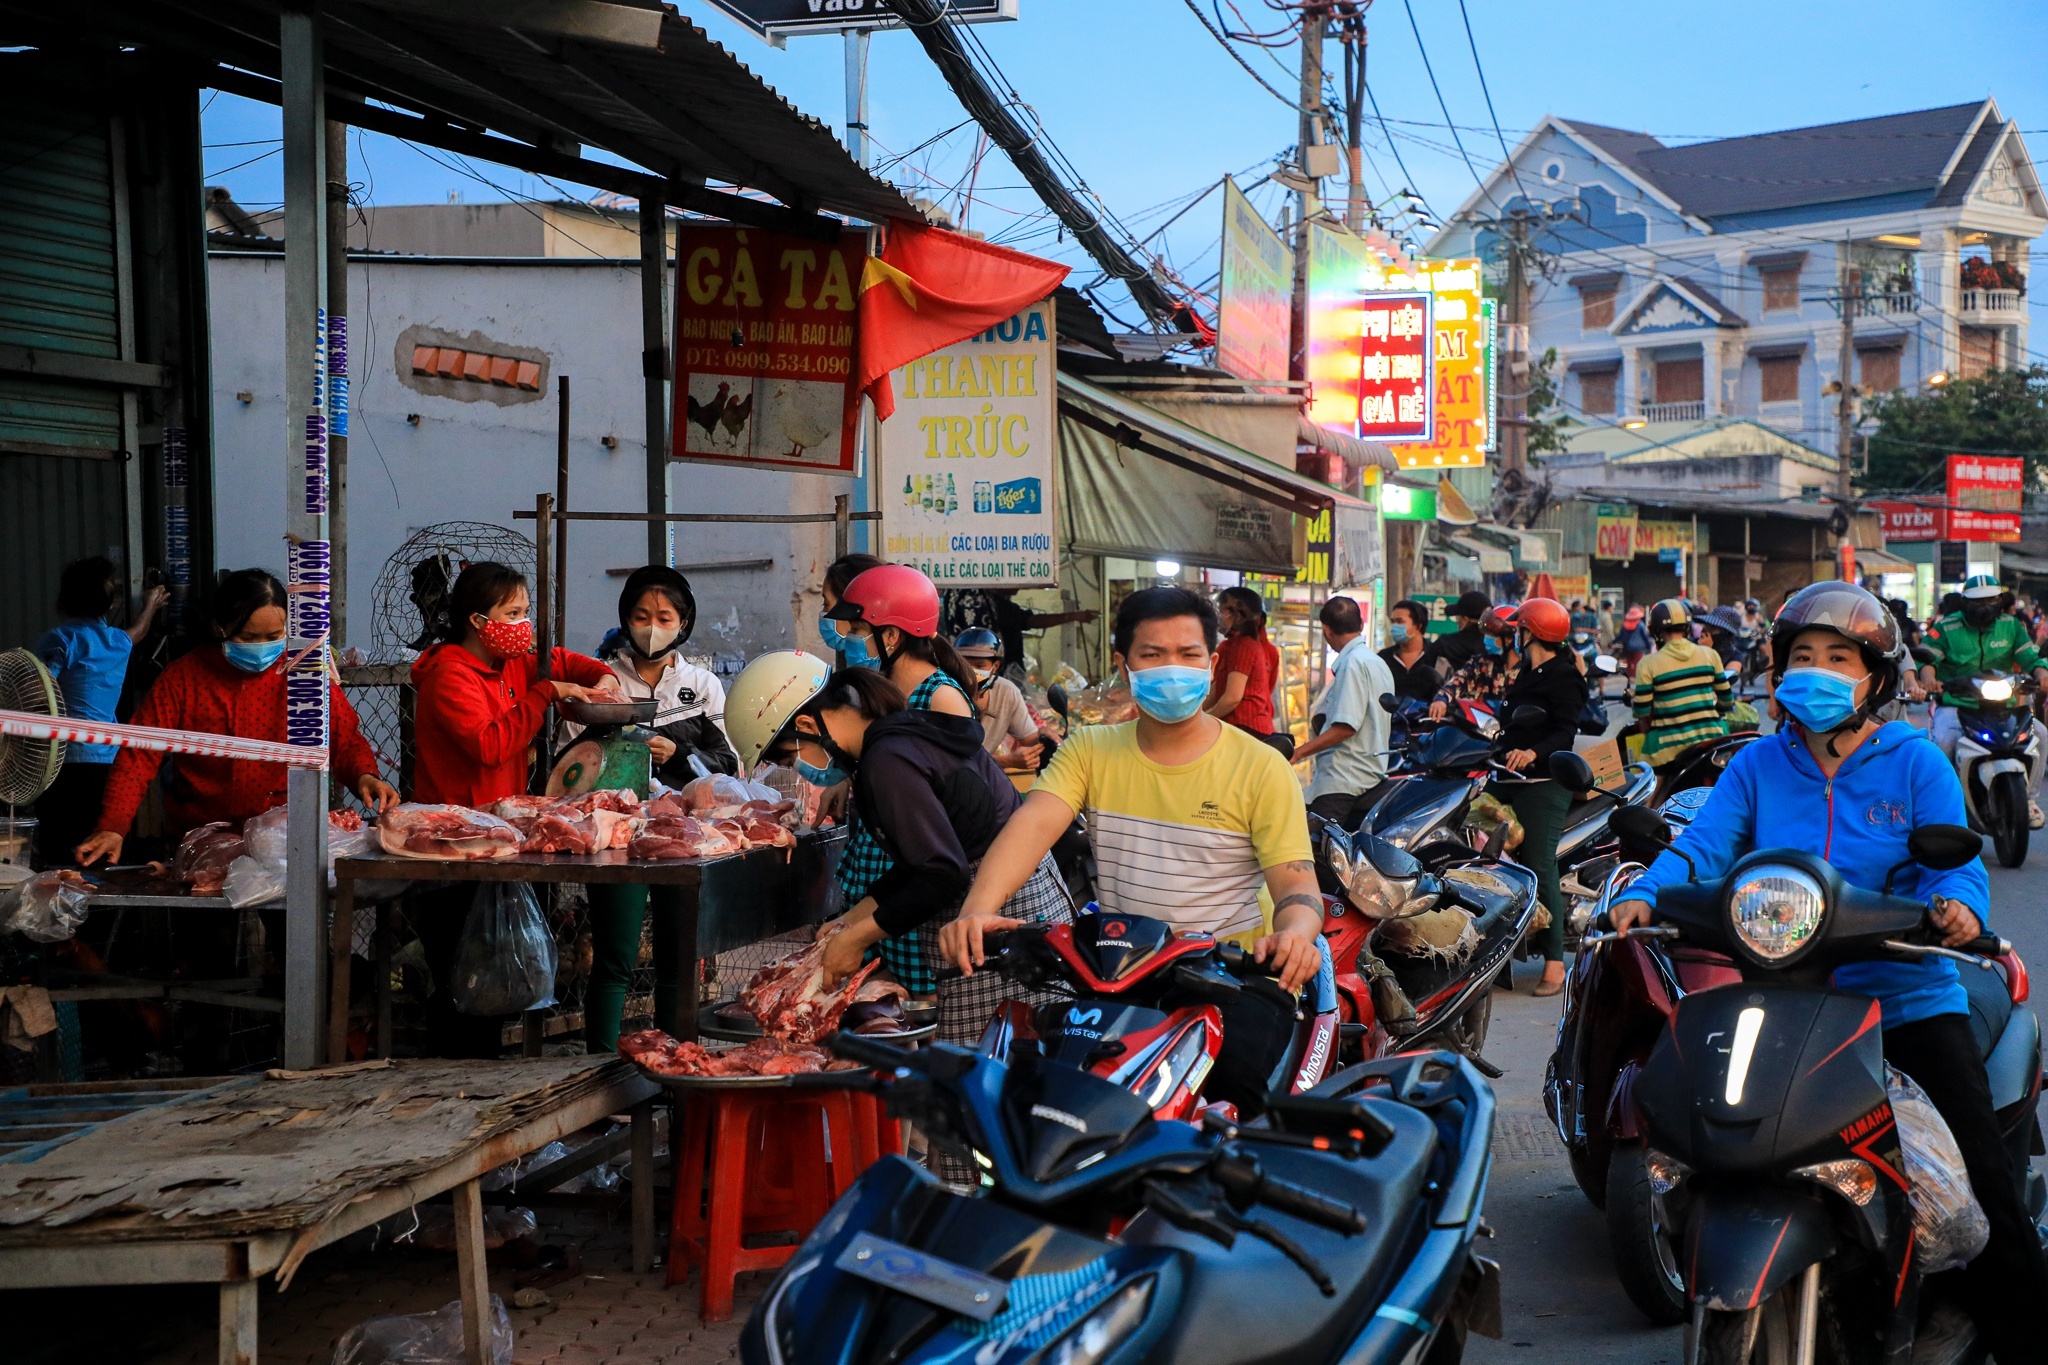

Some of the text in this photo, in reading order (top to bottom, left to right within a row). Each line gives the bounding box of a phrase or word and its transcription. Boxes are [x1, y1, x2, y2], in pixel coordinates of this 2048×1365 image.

[686, 229, 856, 311] GÀ TA
[683, 317, 707, 339] BAO
[751, 321, 774, 343] BAO
[801, 323, 825, 346] BAO
[1434, 329, 1469, 361] M
[725, 350, 850, 375] 0909.534.090
[898, 353, 1038, 399] THANH
[1435, 367, 1475, 405] ÁT
[1362, 390, 1396, 424] GIÁ
[918, 402, 1030, 458] TRÚC
[997, 486, 1026, 510] Tiger
[951, 532, 972, 551] CÁC
[975, 535, 998, 555] LOẠI
[1001, 535, 1019, 551] BIA
[1022, 533, 1050, 555] RƯỢU
[288, 560, 298, 582] GIÁ
[933, 563, 941, 578] &
[959, 558, 979, 578] CÁC
[981, 562, 1005, 581] LOẠI
[1007, 556, 1026, 578] THẺ
[1029, 558, 1050, 578] CÀO
[1095, 939, 1133, 949] HONDA
[1306, 1024, 1330, 1081] movistar
[1031, 1103, 1088, 1134] HONDA
[1839, 1103, 1892, 1145] YAMAHA
